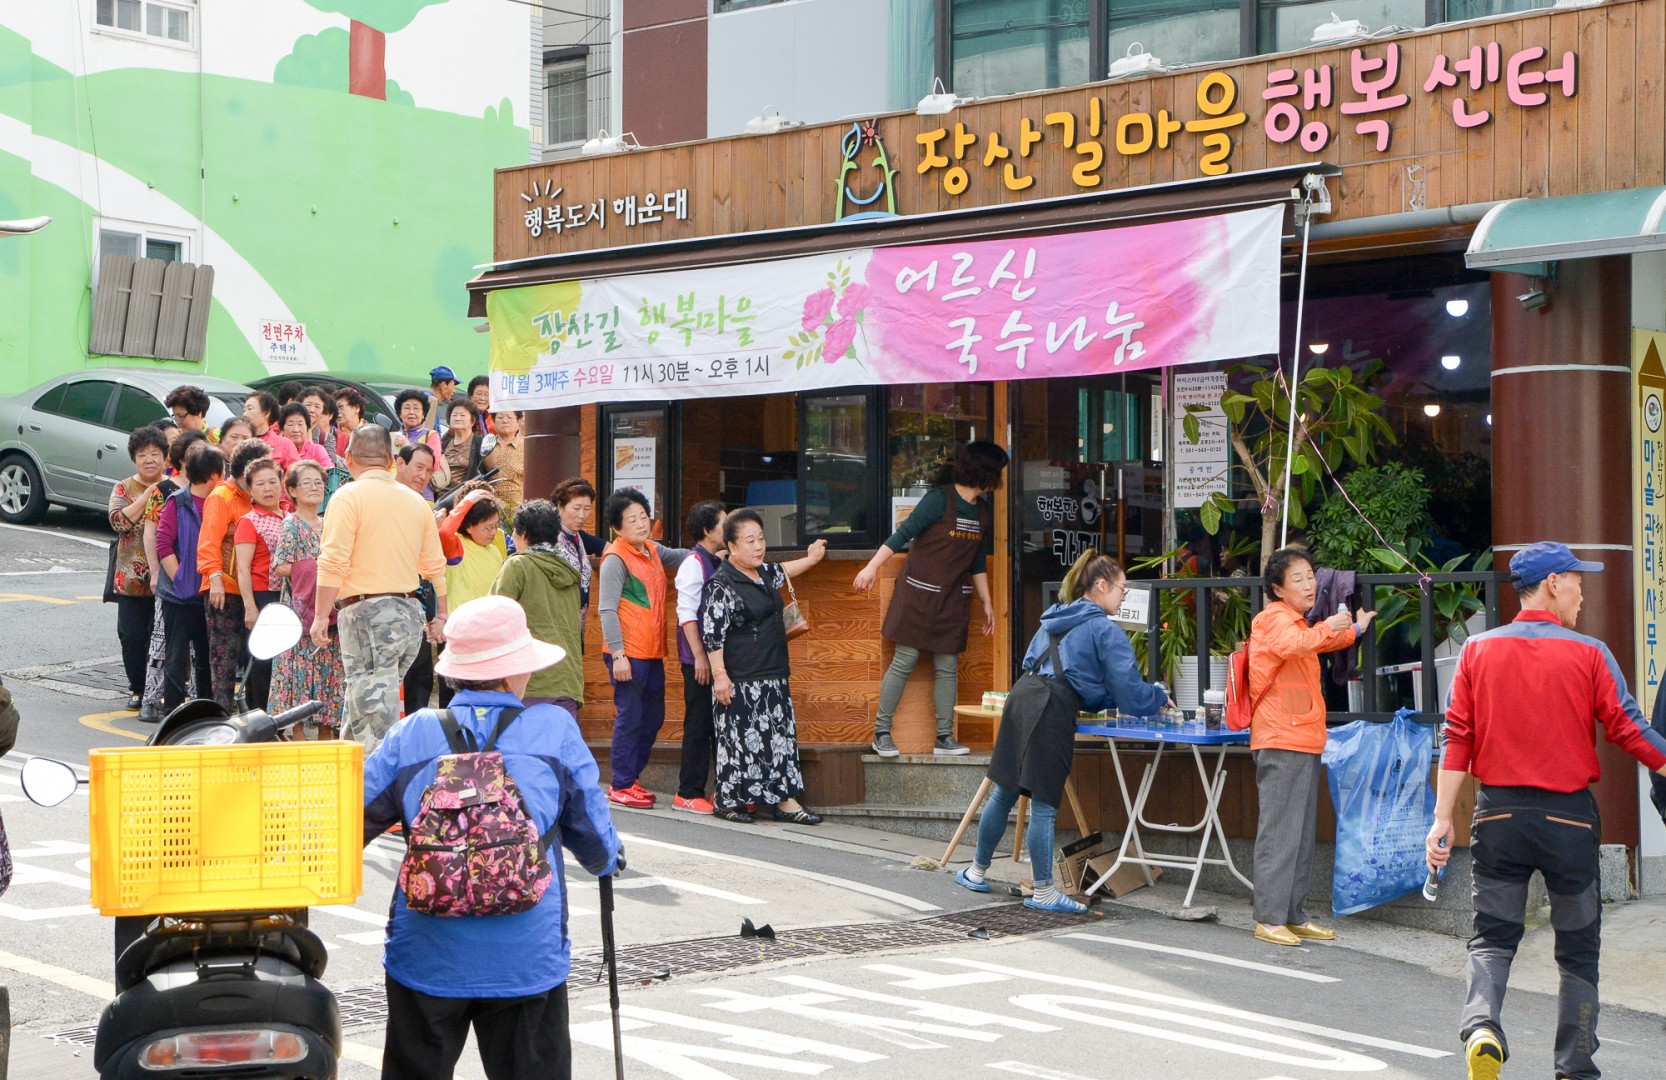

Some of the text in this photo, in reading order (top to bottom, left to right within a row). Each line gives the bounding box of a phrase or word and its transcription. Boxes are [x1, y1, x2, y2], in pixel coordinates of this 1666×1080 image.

[916, 41, 1577, 195] 장산길마을 행복 센터
[524, 188, 688, 238] 행복도시 해운대
[895, 246, 1037, 303] 어르신
[262, 322, 304, 343] 전면주차
[532, 291, 758, 355] 장산길 행복마을
[944, 300, 1146, 375] 국수나눔
[501, 374, 530, 394] 매월
[535, 370, 570, 393] 3째주
[573, 364, 615, 388] 수요일
[623, 362, 654, 384] 11시
[658, 360, 690, 383] 30분
[708, 358, 739, 379] 오후
[745, 354, 770, 376] 1시
[1644, 439, 1655, 506] 마을
[1036, 495, 1078, 522] 행복한
[1644, 513, 1656, 580] 관리
[1645, 588, 1658, 686] 사무소
